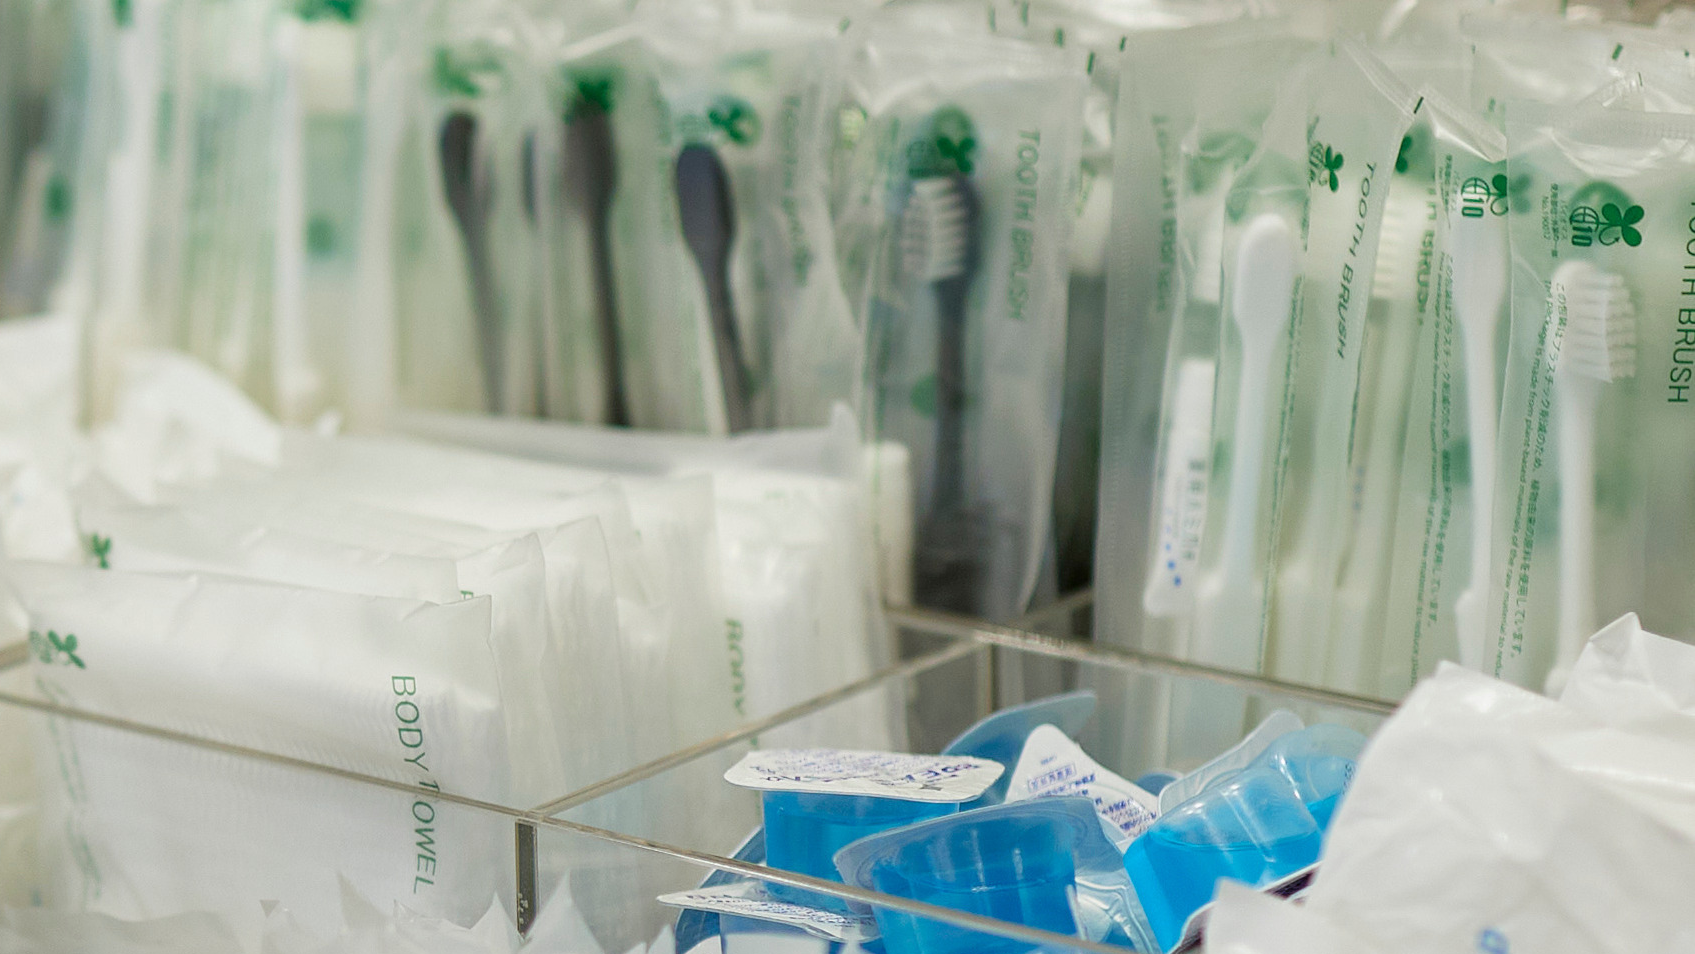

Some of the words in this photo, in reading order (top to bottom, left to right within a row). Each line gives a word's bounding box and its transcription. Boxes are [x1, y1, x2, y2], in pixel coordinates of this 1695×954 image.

[1349, 161, 1377, 257] TOOTH
[1337, 263, 1354, 359] BRUSH
[1668, 309, 1695, 402] BRUSH
[391, 675, 429, 772] BODY
